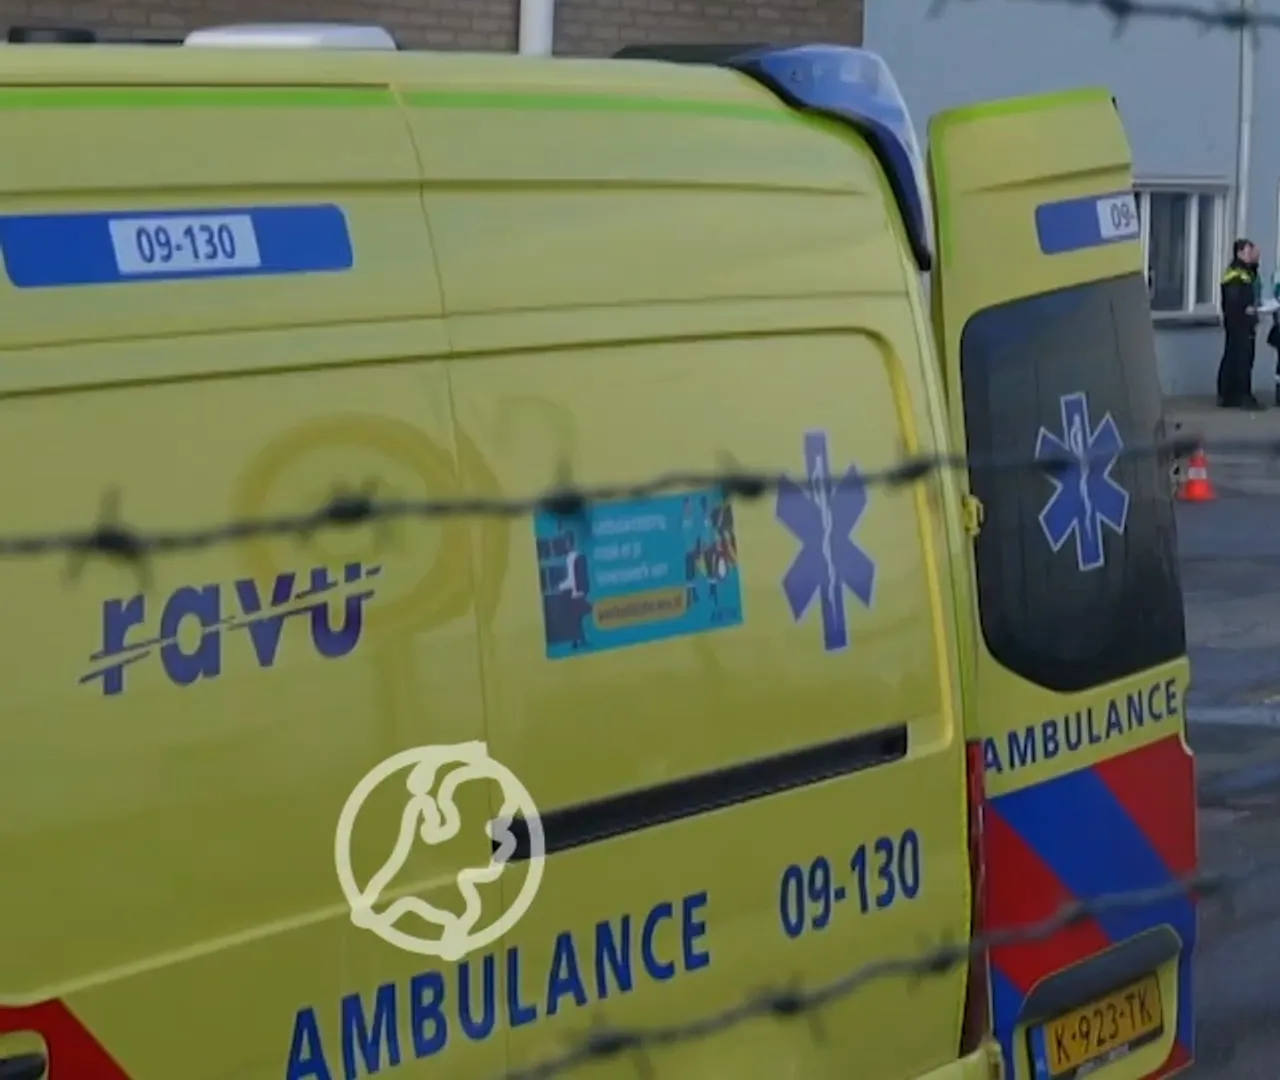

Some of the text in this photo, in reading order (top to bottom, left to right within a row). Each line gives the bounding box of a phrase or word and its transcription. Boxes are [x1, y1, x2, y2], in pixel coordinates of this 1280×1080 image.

[135, 223, 236, 263] 09-130
[983, 677, 1178, 774] AMBULANCE
[779, 828, 920, 939] 09-130
[285, 891, 711, 1080] AMBULANCE
[1054, 986, 1153, 1066] K-923-TK
